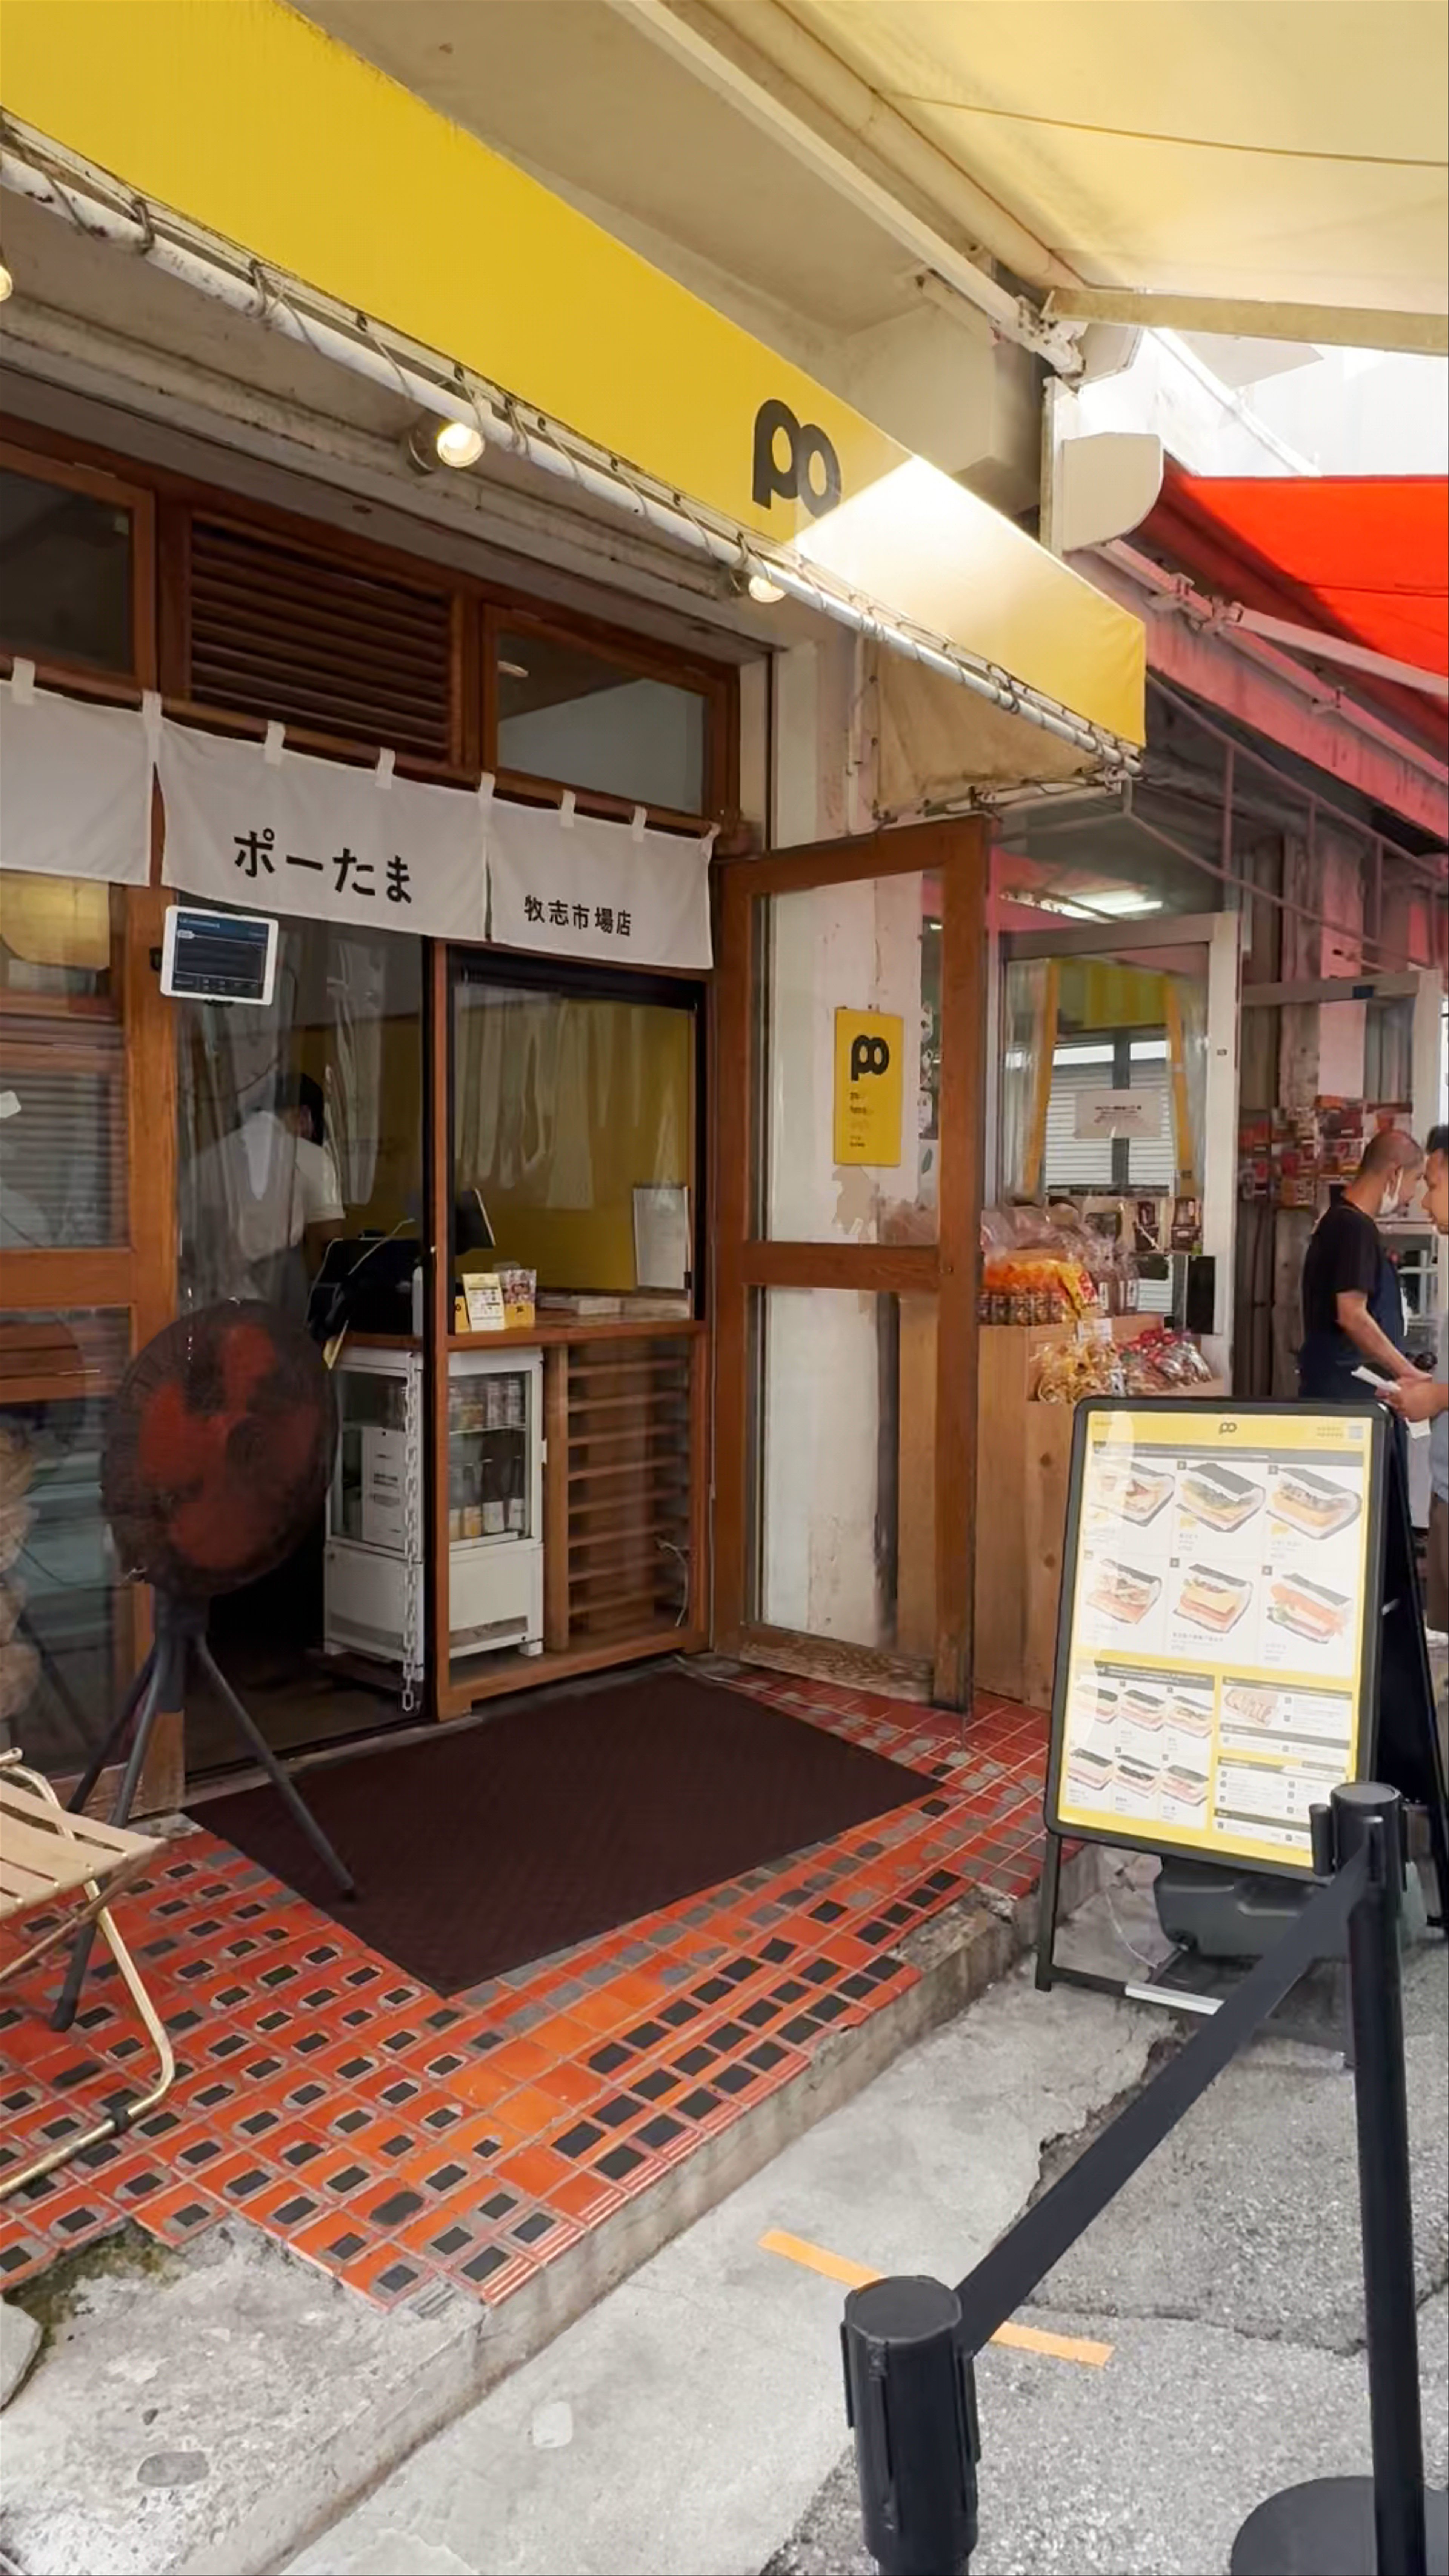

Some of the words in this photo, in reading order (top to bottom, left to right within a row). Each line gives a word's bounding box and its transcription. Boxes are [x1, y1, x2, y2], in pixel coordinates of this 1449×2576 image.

[233, 828, 413, 905] ポーたま
[524, 895, 632, 937] 牧志市場店
